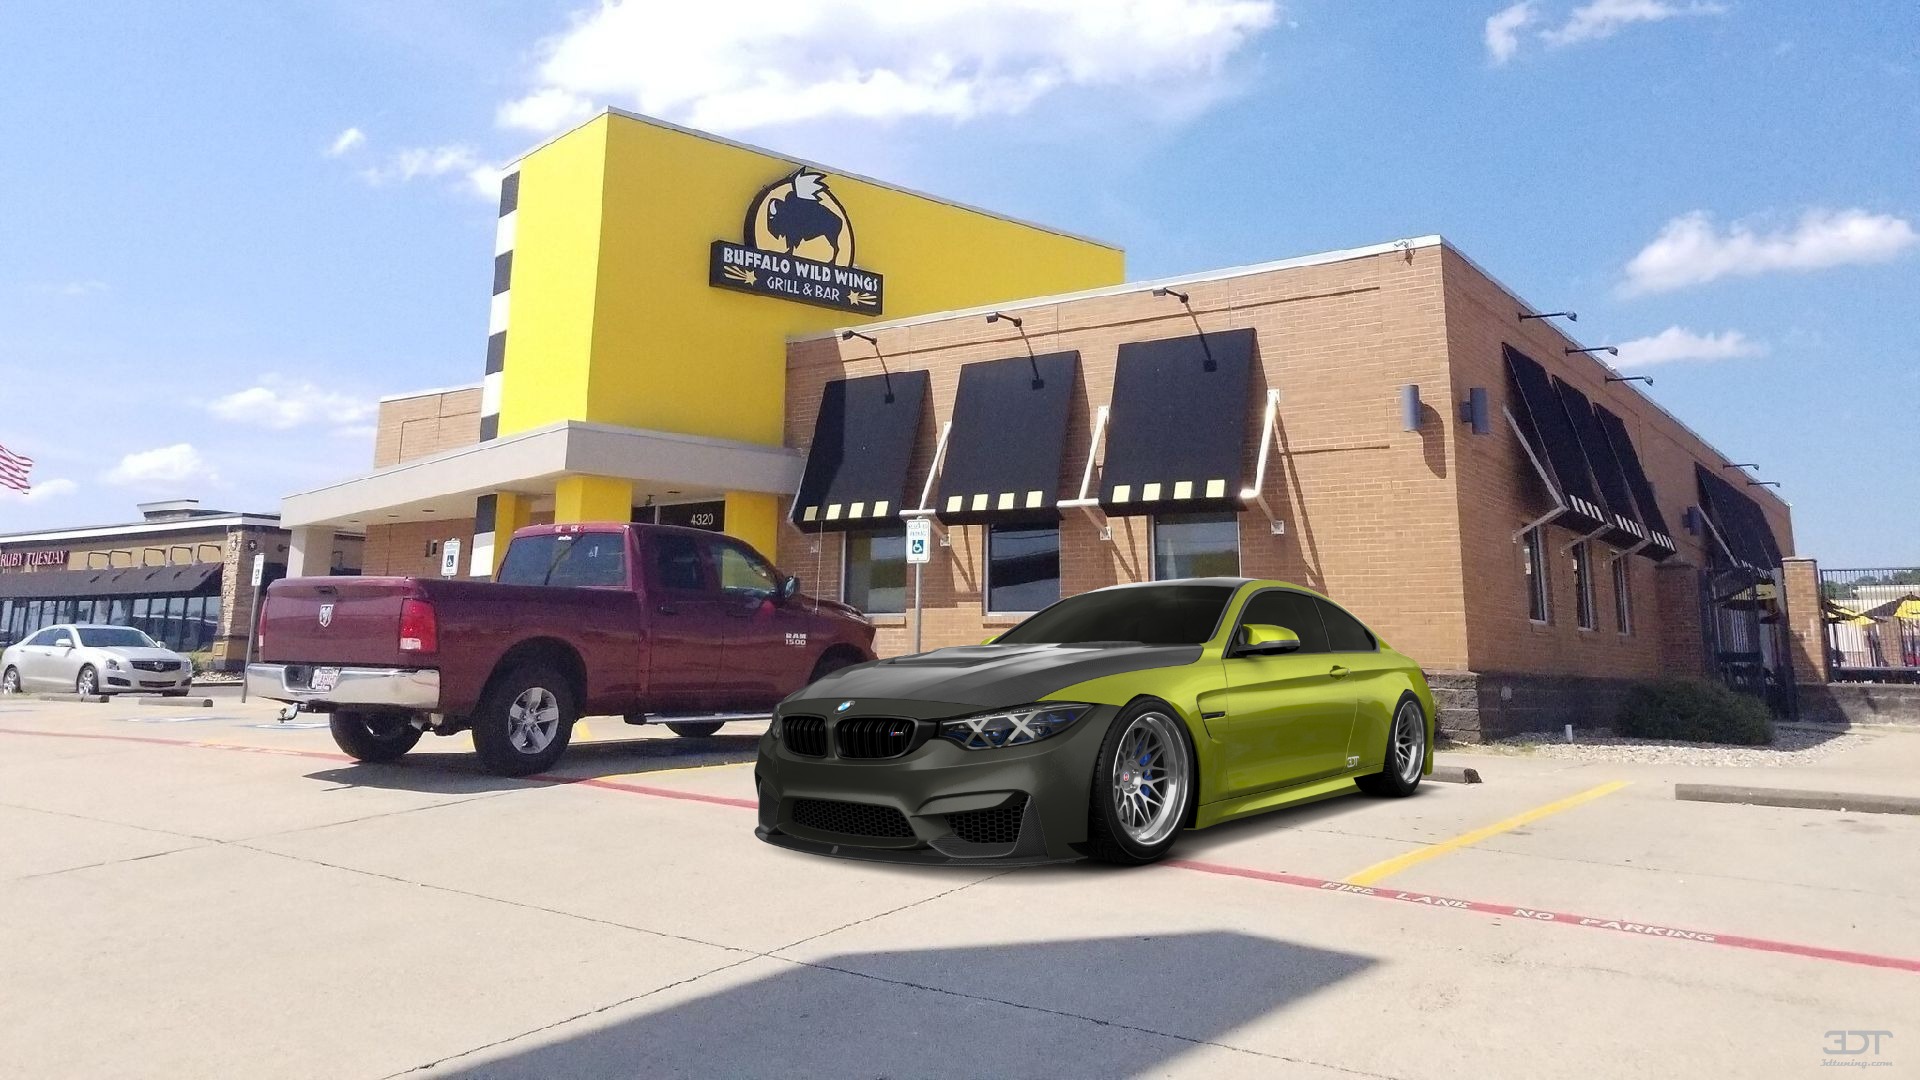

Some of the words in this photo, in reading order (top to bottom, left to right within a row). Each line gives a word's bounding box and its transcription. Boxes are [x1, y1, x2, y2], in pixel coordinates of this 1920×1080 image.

[723, 247, 791, 274] BUFFALO
[794, 261, 831, 282] WILD
[834, 269, 878, 292] WINGS
[766, 276, 800, 295] GRILL
[802, 282, 812, 297] &
[815, 286, 841, 302] BAR
[691, 513, 714, 526] 4320
[0, 553, 22, 567] RUBY
[26, 550, 67, 566] TUESDAY
[1319, 881, 1376, 895] FIRE
[1396, 892, 1472, 909] LANE
[1512, 908, 1555, 920] NO
[1579, 917, 1716, 942] PARKING
